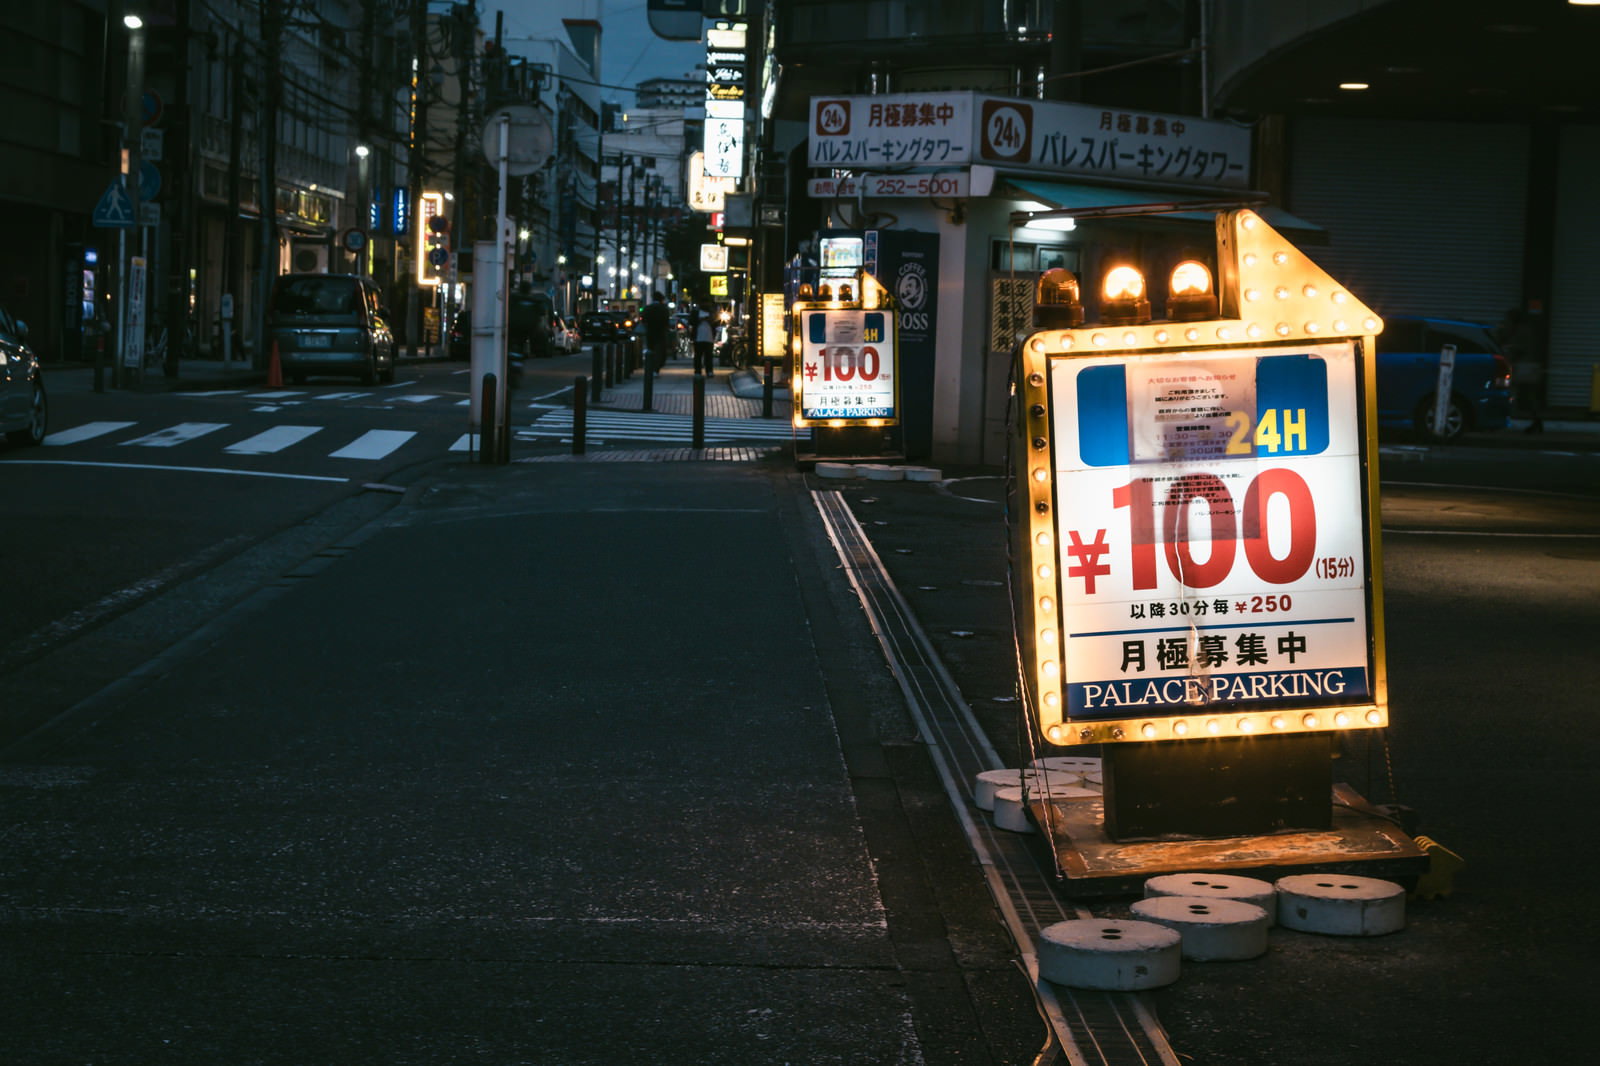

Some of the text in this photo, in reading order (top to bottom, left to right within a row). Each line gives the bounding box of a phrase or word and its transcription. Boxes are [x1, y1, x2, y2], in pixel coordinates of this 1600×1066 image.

[869, 103, 953, 127] 月極募集中
[994, 112, 1185, 149] 24h 月極募集中
[815, 138, 963, 161] パレスパーキングタワー
[1040, 132, 1243, 181] パレスパーキングタワー
[876, 179, 958, 195] 252-5001
[899, 262, 926, 277] COFFEE
[805, 346, 880, 382] ¥100
[846, 407, 887, 417] PARKING
[1225, 408, 1307, 454] 24H
[1068, 467, 1355, 594] ¥100 (15分)
[1130, 595, 1292, 618] 以降30分毎 ¥250
[1120, 631, 1307, 672] 月極募集中
[1083, 671, 1346, 708] PALACE PARKING
